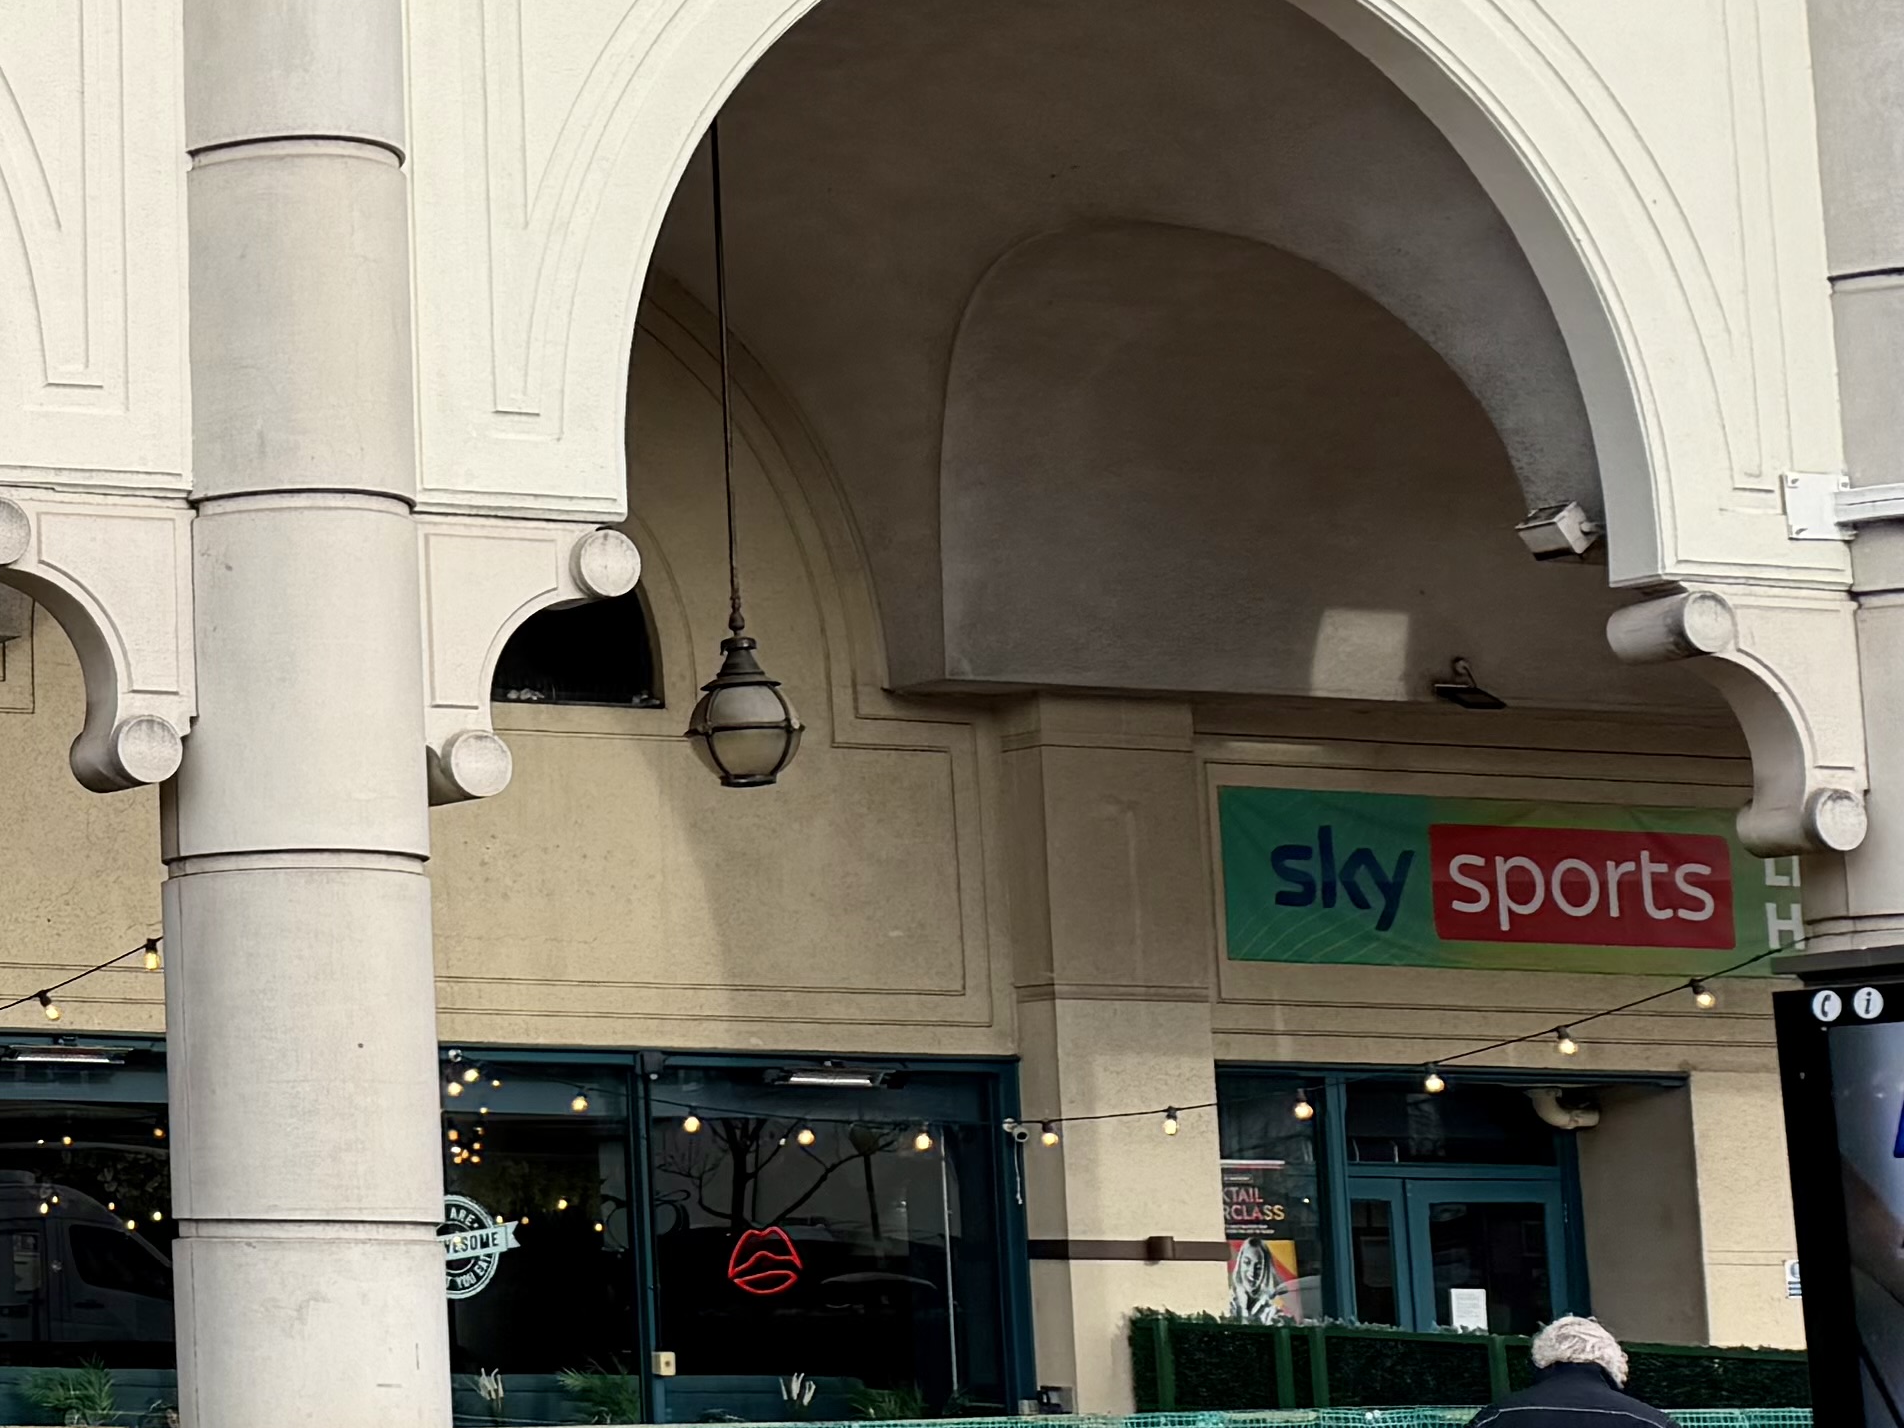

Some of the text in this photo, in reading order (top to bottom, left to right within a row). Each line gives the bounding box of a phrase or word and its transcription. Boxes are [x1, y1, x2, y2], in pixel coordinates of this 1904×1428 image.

[1270, 825, 1716, 932] sky sports
[450, 1206, 476, 1227] ARE
